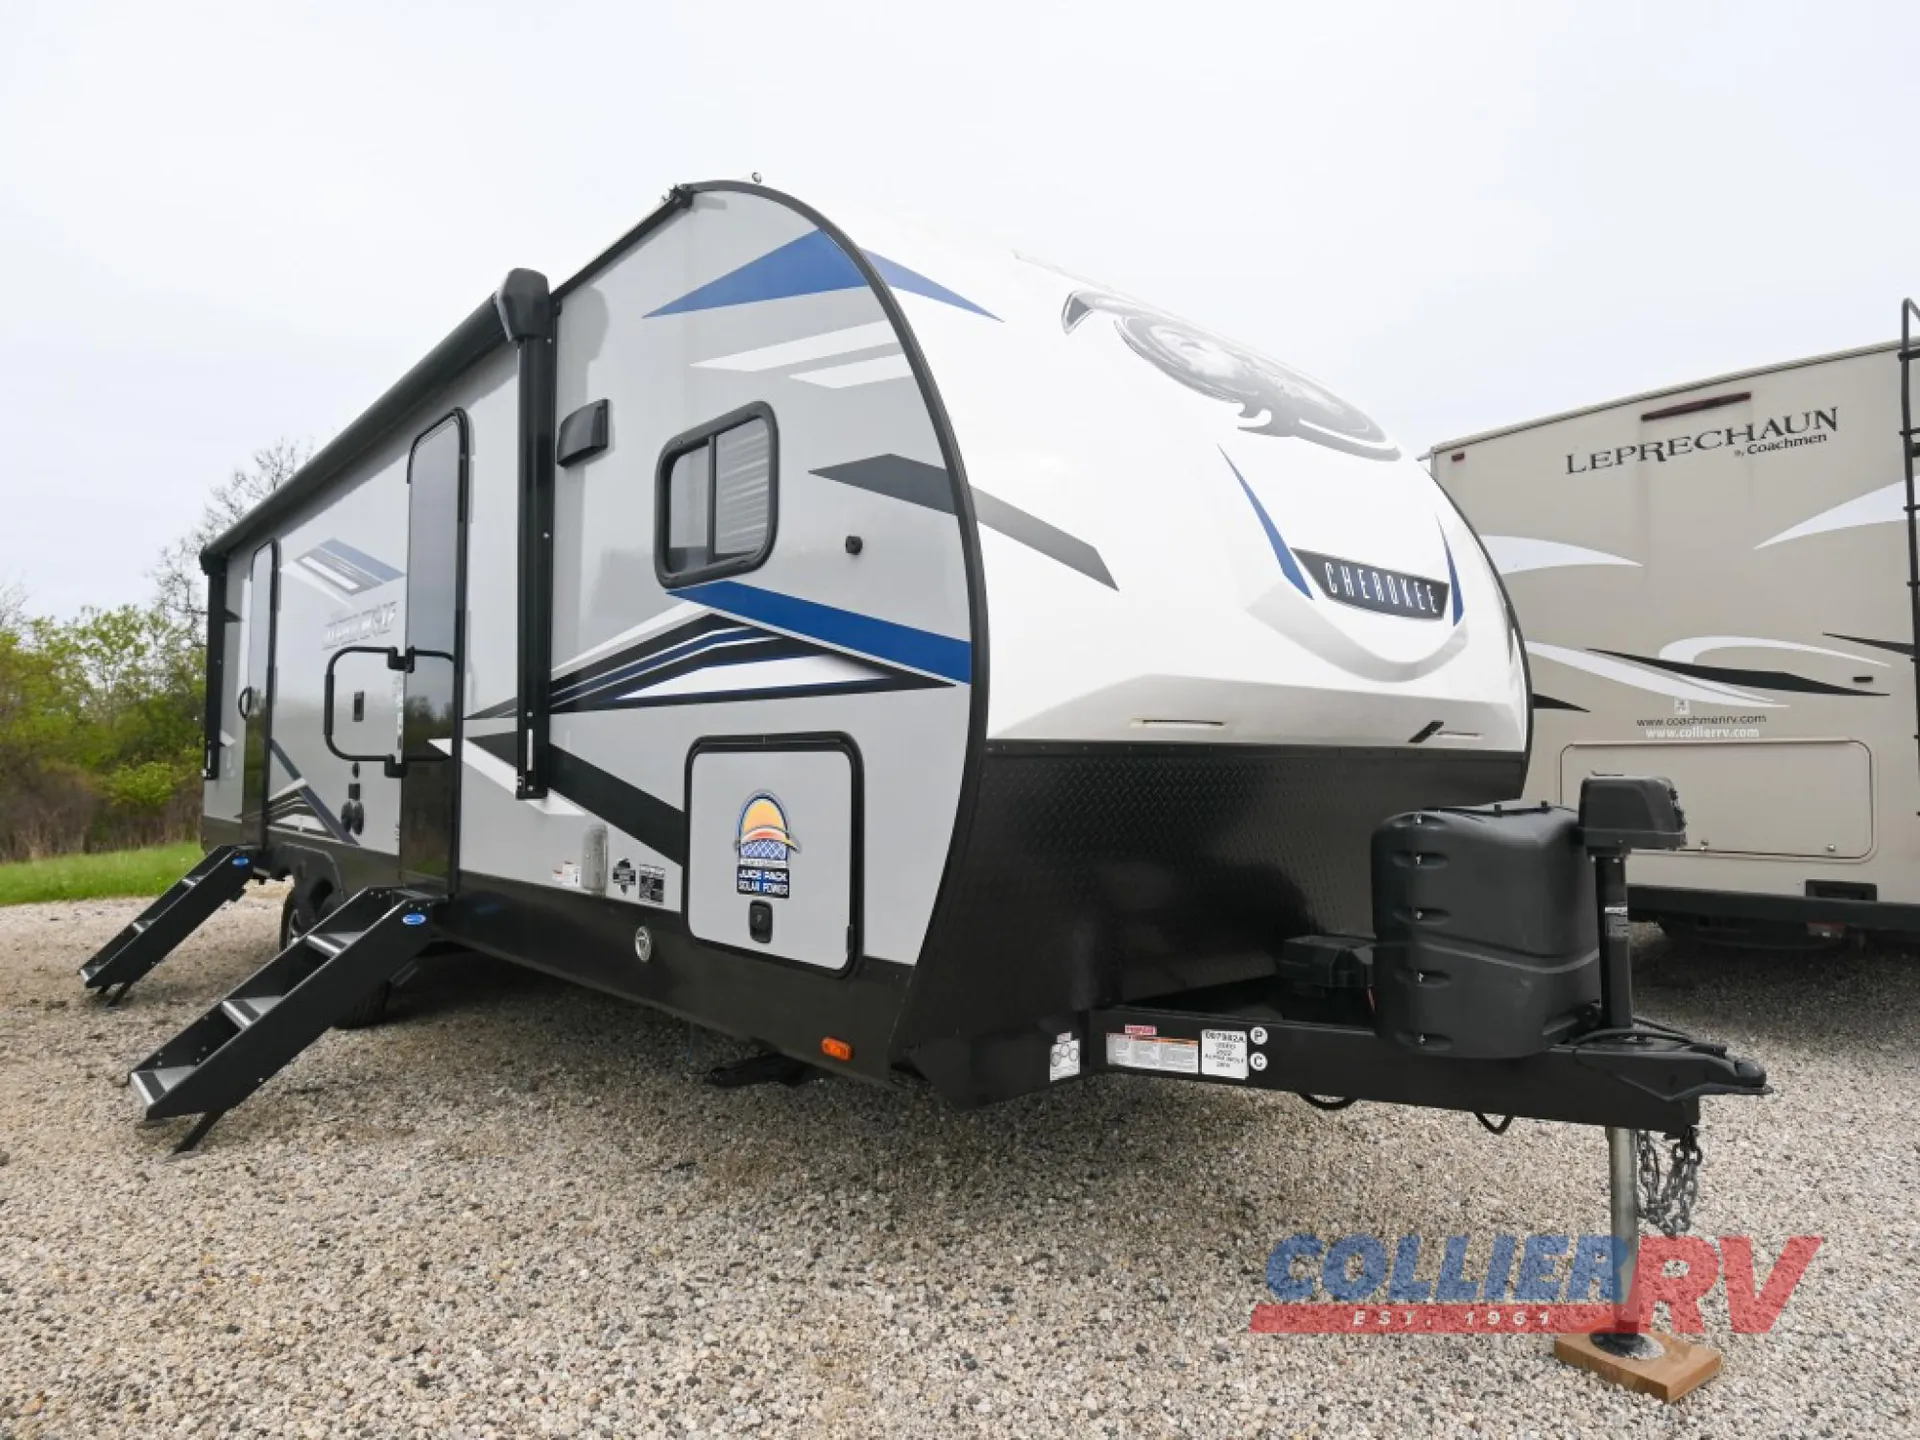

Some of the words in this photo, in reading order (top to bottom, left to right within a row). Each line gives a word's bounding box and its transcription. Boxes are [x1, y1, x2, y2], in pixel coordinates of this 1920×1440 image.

[1565, 406, 1838, 475] LEPRECHAUN
[1747, 433, 1827, 454] Coachmen
[1324, 561, 1438, 614] CHEROKEE
[1636, 713, 1767, 727] www.coachmenrv.com
[1645, 725, 1760, 738] www.collierrv.com
[763, 870, 788, 882] PACK
[762, 882, 788, 896] POWER
